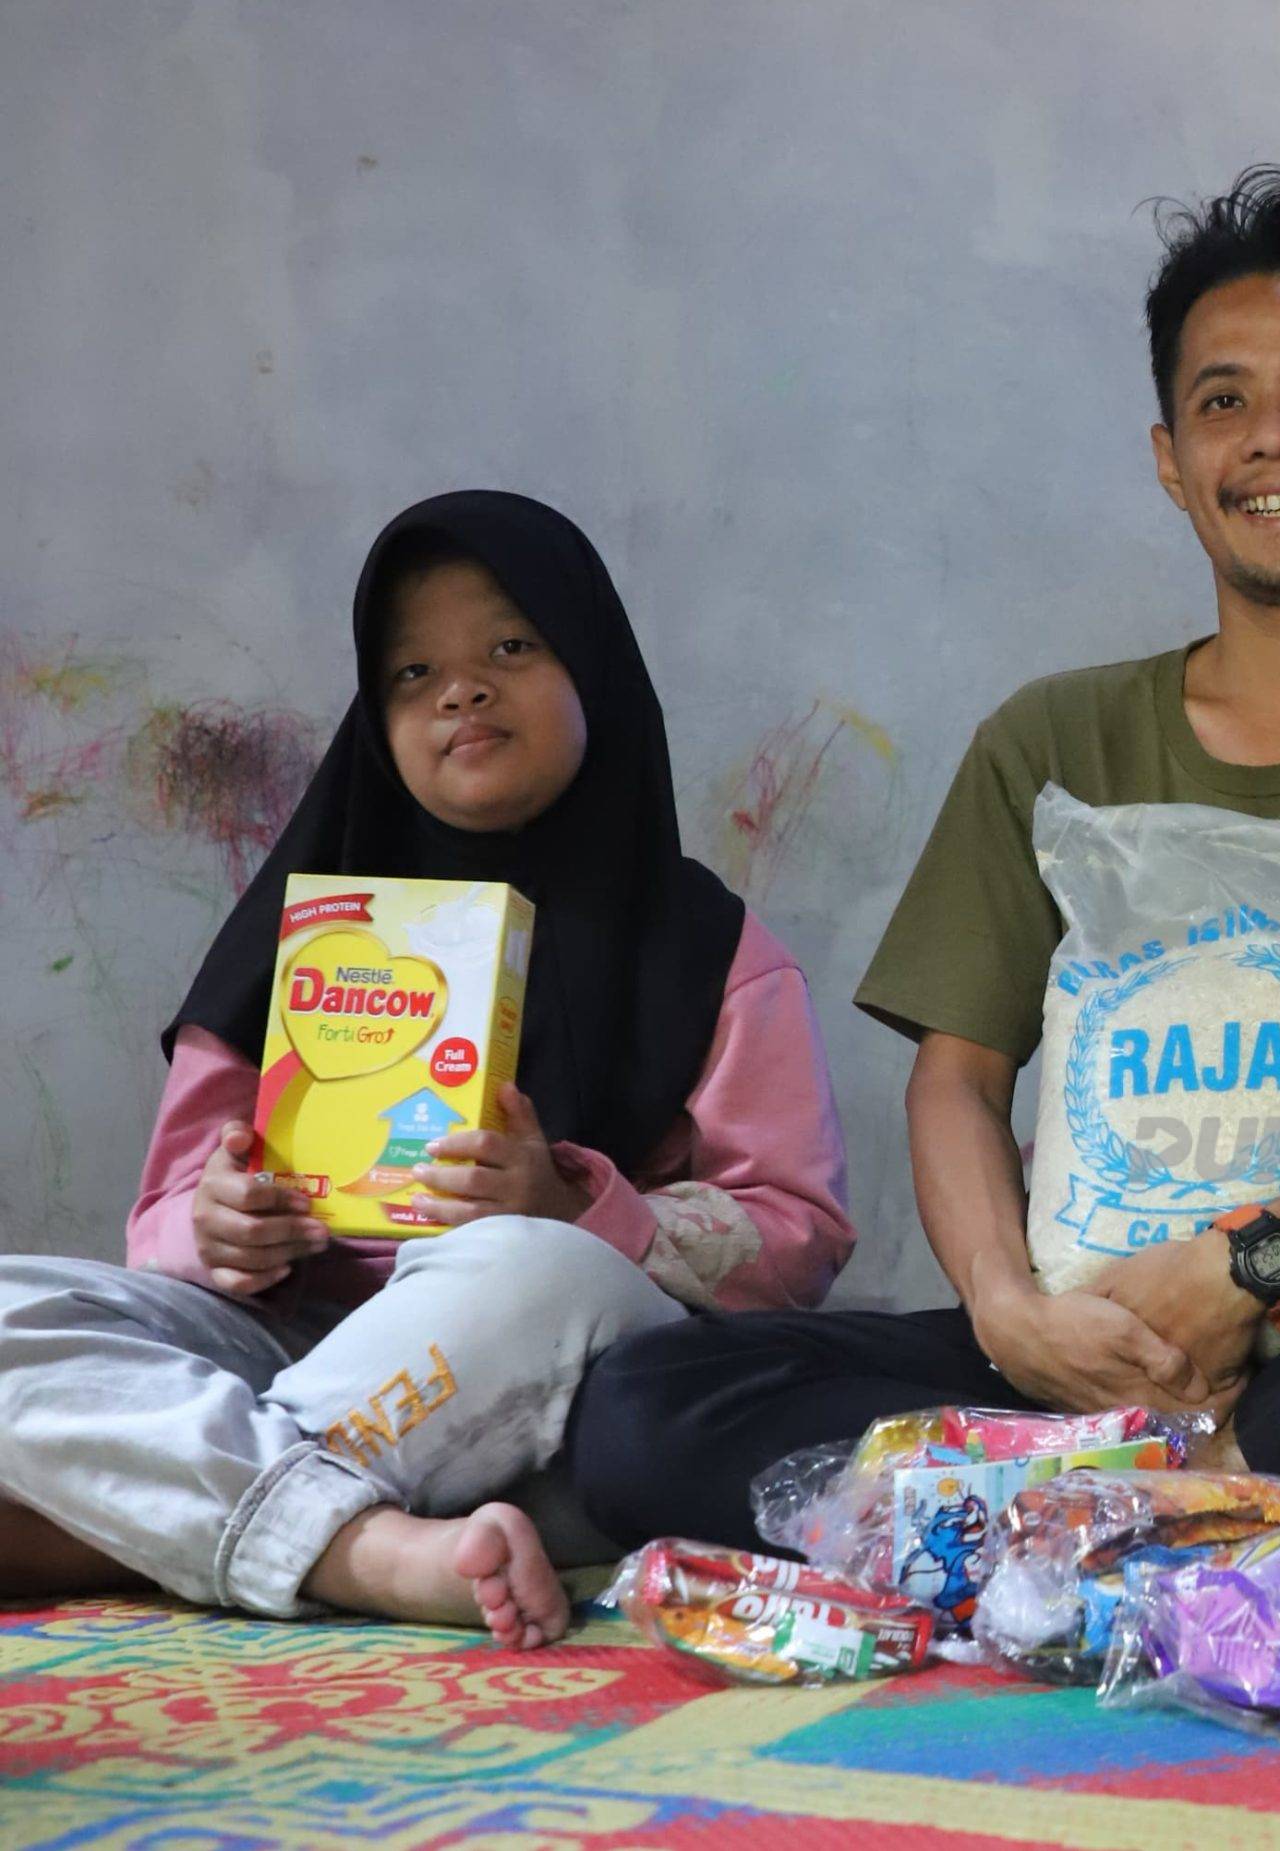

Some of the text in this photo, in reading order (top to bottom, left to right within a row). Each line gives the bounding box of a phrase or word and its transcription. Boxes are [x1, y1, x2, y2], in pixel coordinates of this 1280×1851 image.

[290, 901, 361, 922] HIGH PROTEIN
[289, 967, 436, 1018] Dancow
[444, 1049, 465, 1060] Full
[434, 1062, 471, 1072] Cream
